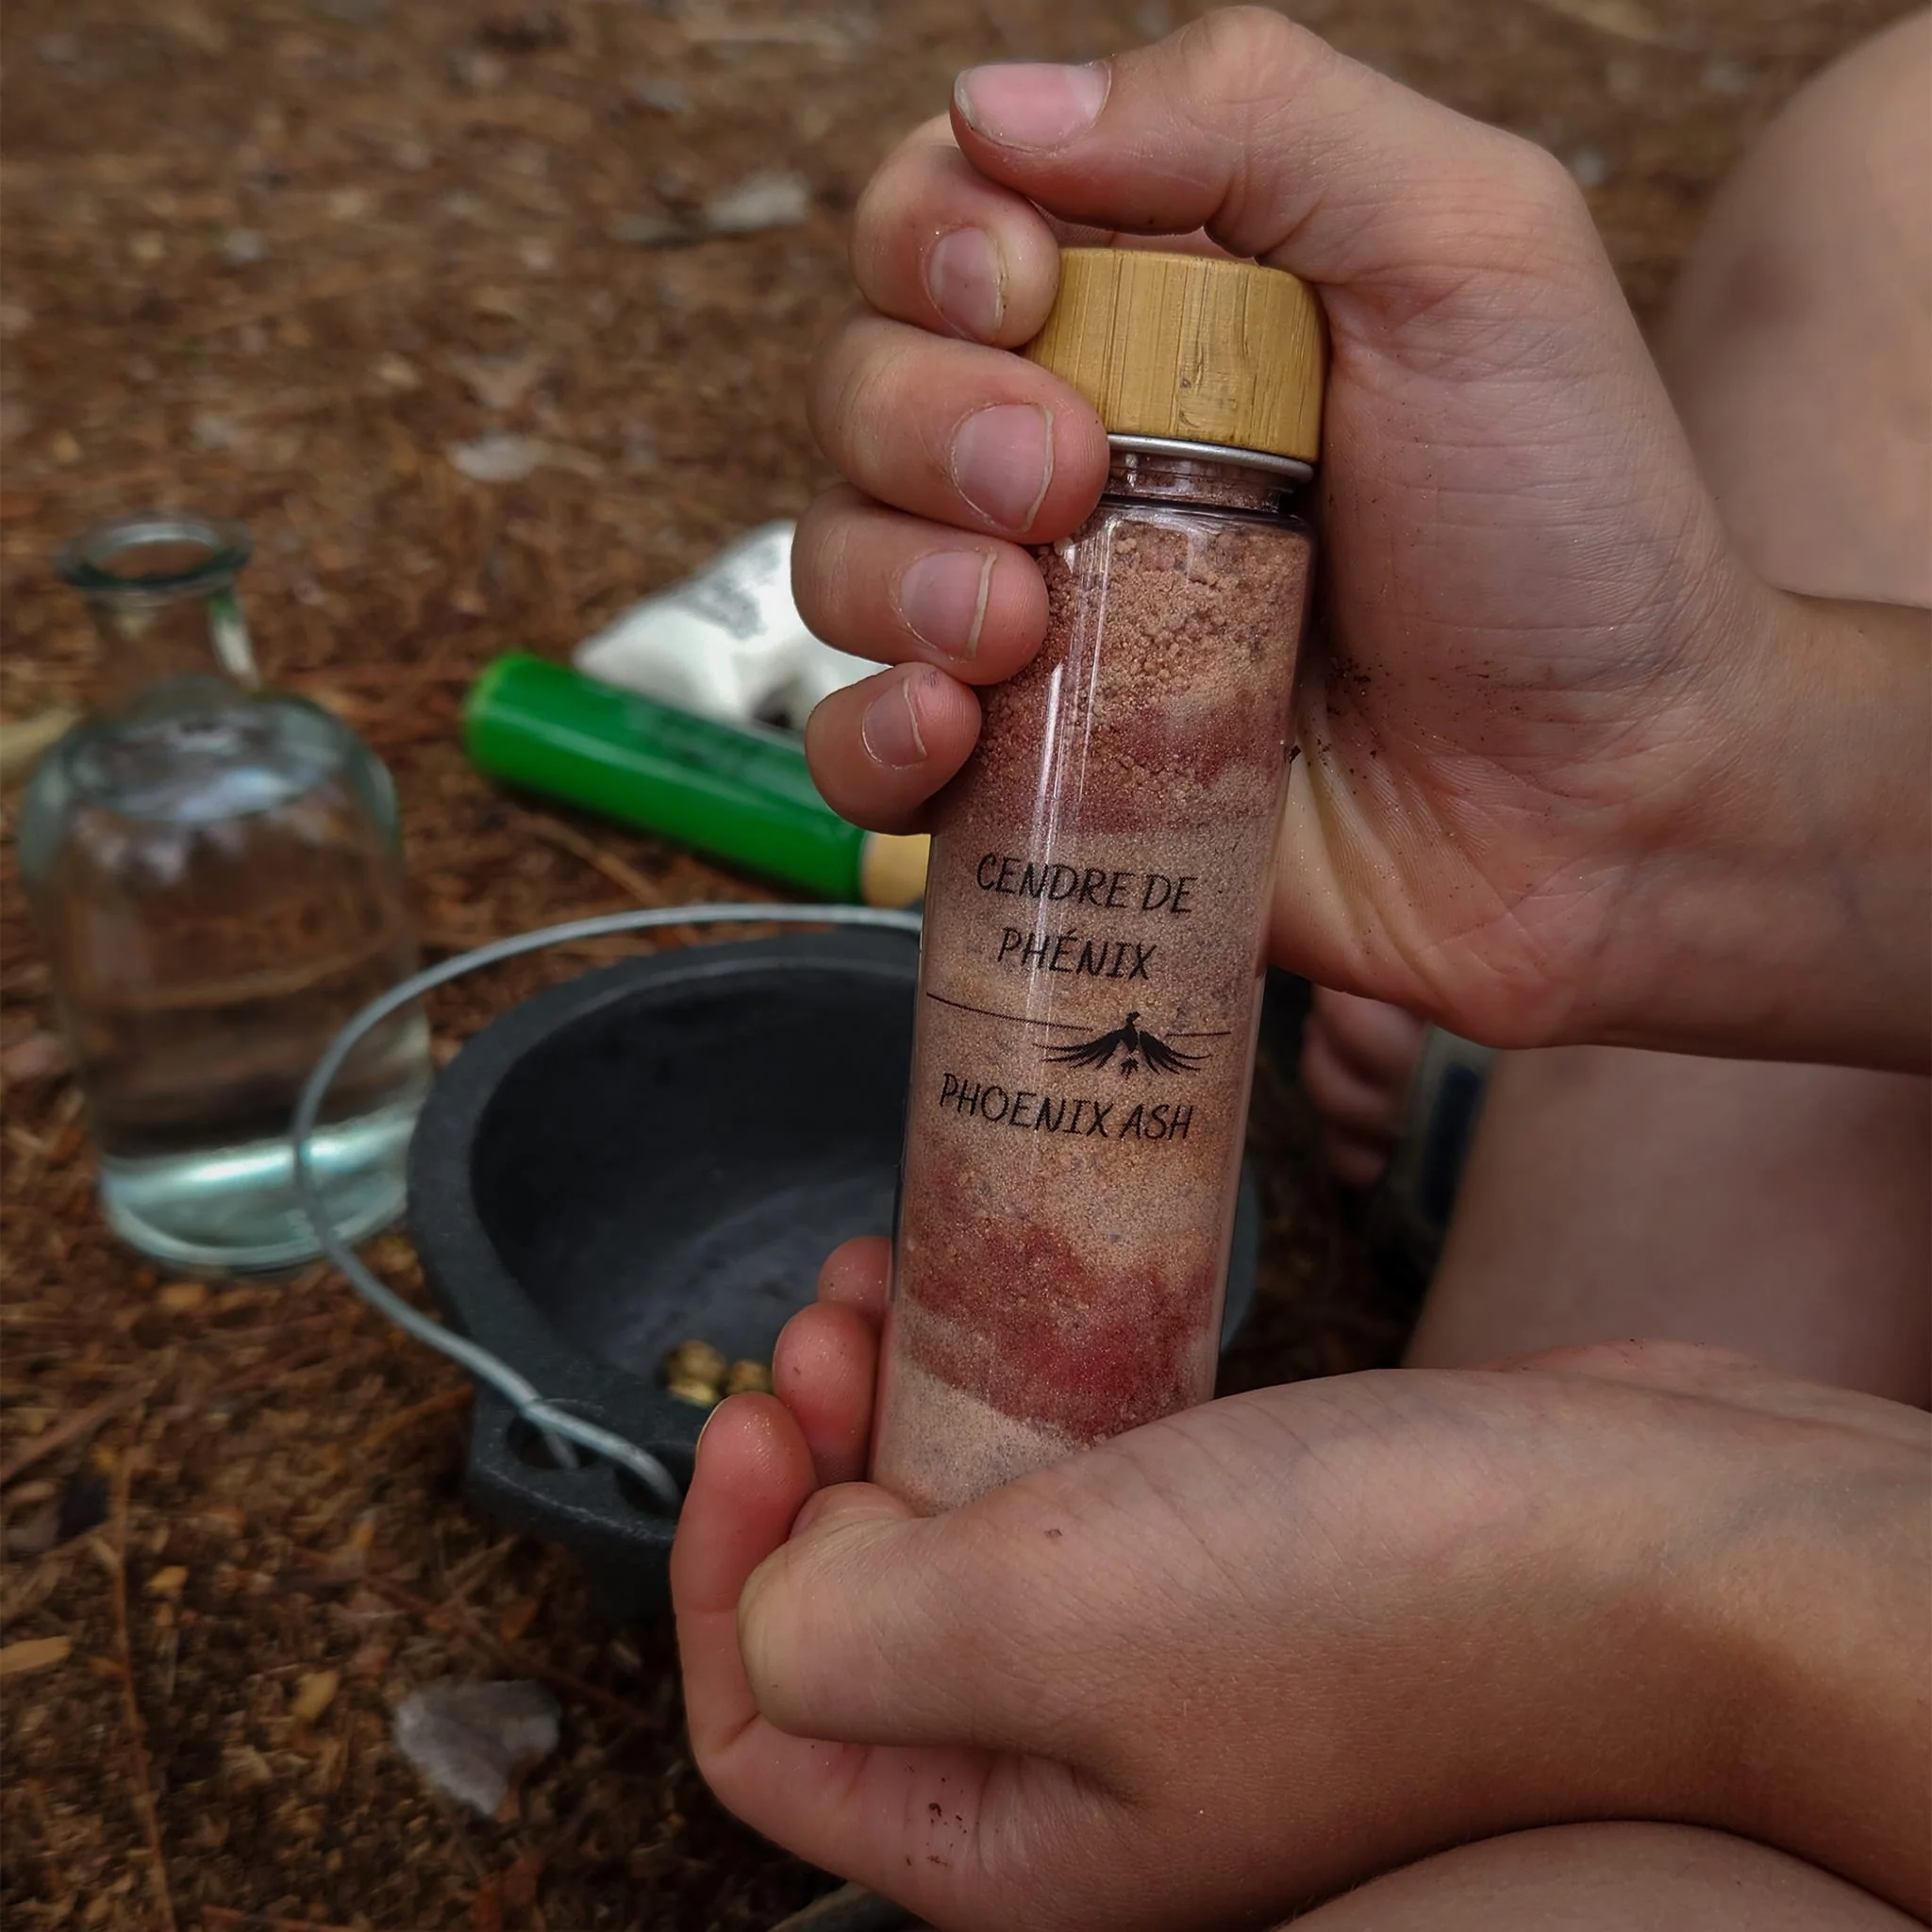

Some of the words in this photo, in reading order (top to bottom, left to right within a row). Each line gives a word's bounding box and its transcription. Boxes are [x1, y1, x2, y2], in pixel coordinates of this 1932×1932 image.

[975, 852, 1135, 908] CENDRE
[1141, 869, 1198, 914] DE
[996, 926, 1158, 981] PHÉNIX
[939, 1072, 1114, 1139] PHOENIX
[1120, 1103, 1194, 1141] ASH
